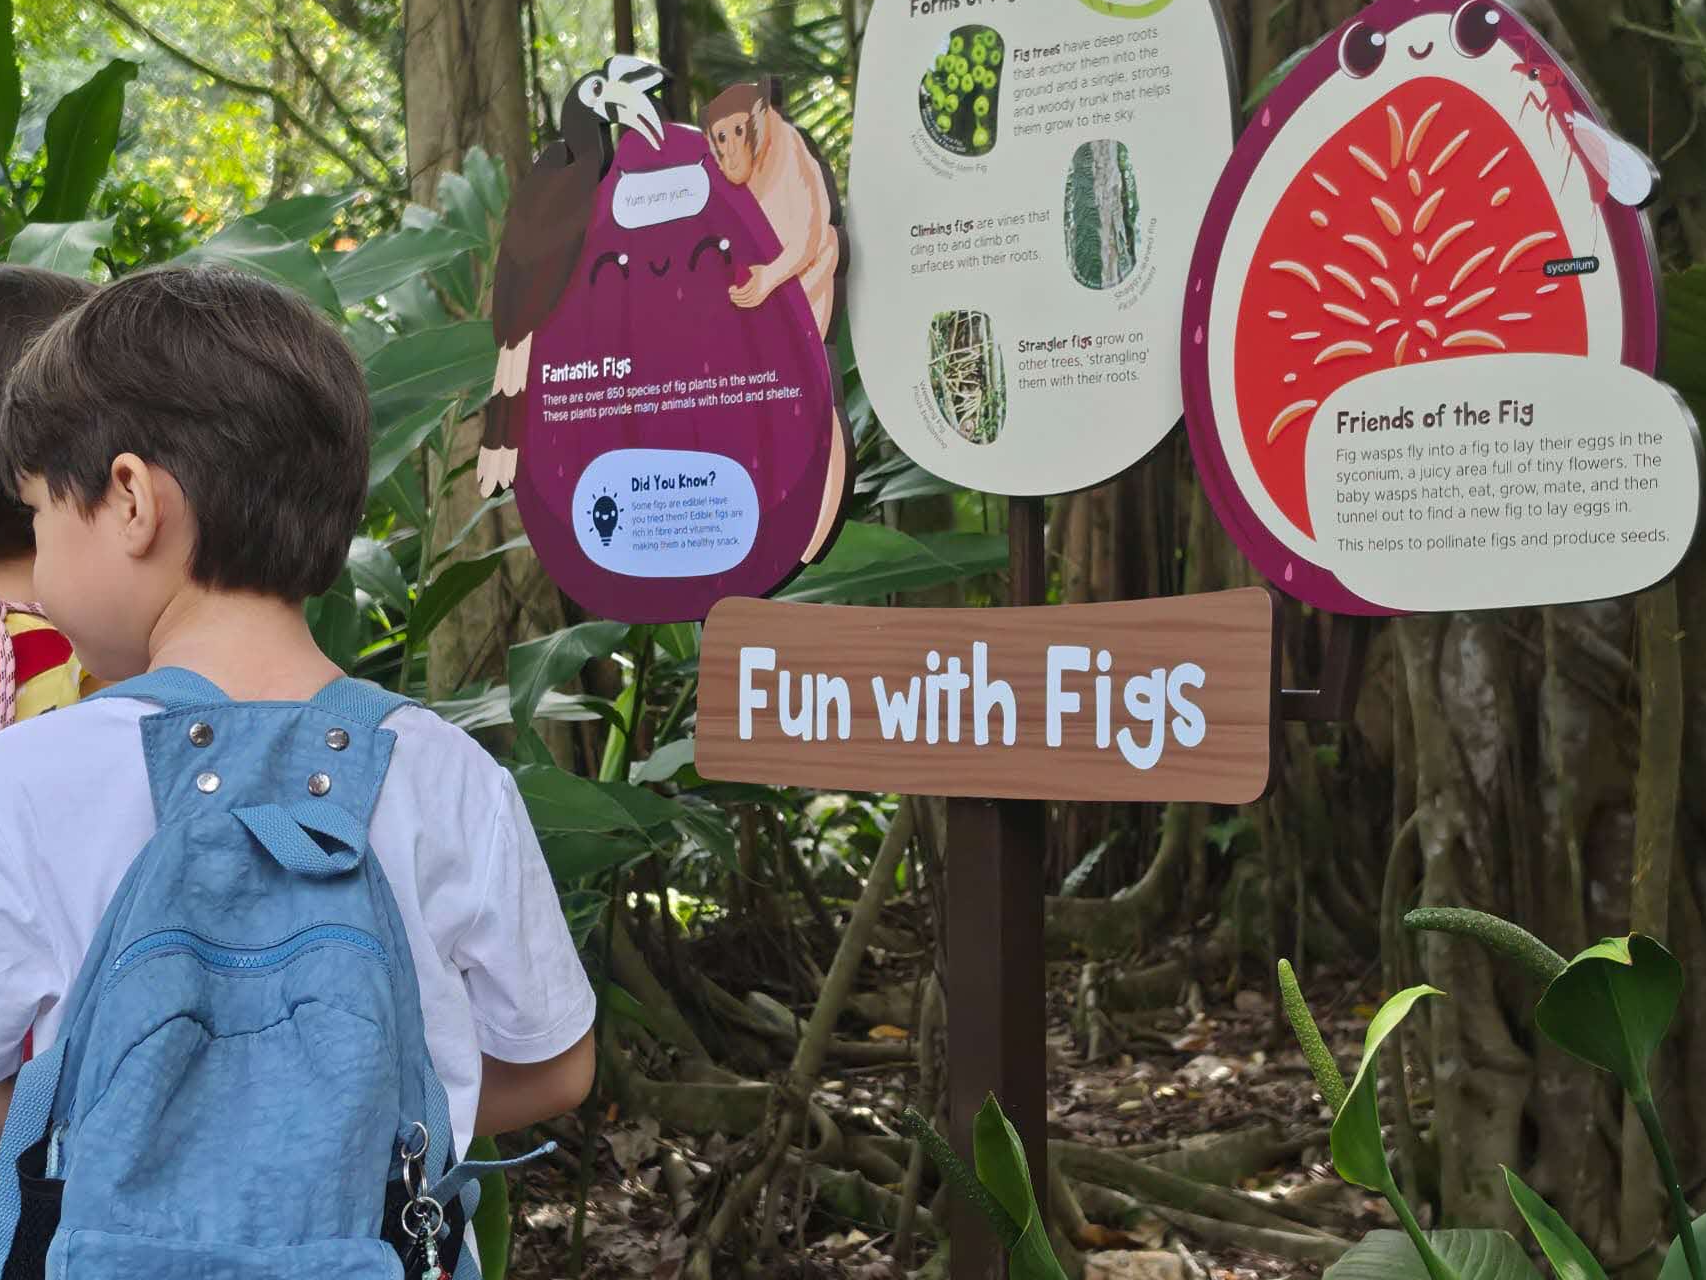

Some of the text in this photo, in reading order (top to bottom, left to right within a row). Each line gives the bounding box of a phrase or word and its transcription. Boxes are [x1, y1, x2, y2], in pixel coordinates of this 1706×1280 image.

[1013, 28, 1158, 62] Fig trees have deep roots
[1013, 47, 1159, 80] that anchor them into the
[1013, 81, 1054, 101] ground
[1056, 77, 1078, 92] and
[1081, 77, 1088, 88] a
[1013, 83, 1171, 117] and woody trunk that helps
[1013, 122, 1042, 136] them
[1044, 119, 1074, 134] grow
[1077, 115, 1089, 127] to
[1092, 112, 1111, 124] the
[910, 210, 1050, 237] Climbing figs are vines that
[910, 233, 1020, 256] cling to and climb on
[911, 249, 1043, 274] surfaces with their roots.
[1545, 259, 1595, 276] syconium
[1018, 332, 1143, 353] Strangler figs grow on
[542, 357, 632, 383] Fantastic Figs
[1018, 349, 1150, 370] other trees, 'strangling'
[543, 371, 778, 405] There are over 850 species of fig plants in the world.
[1018, 369, 1139, 389] them with their roots.
[543, 387, 802, 421] These plants provide many animals with food and shelter.
[1337, 400, 1535, 433] Friends of the Fig
[1336, 431, 1663, 464] Fig wasps fly into a fig to lay their eggs in the
[631, 470, 717, 492] Did You Know?
[1336, 453, 1662, 484] syconium, a juicy area full of tiny flowers. The
[1336, 475, 1658, 504] baby wasps hatch, eat, grow, mate, and then
[1337, 499, 1634, 523] tunnel out to find a new fig to lay eggs in.
[1338, 529, 1669, 551] This helps to pollinate figs and produce seeds.
[738, 640, 1207, 771] Fun with Figs
